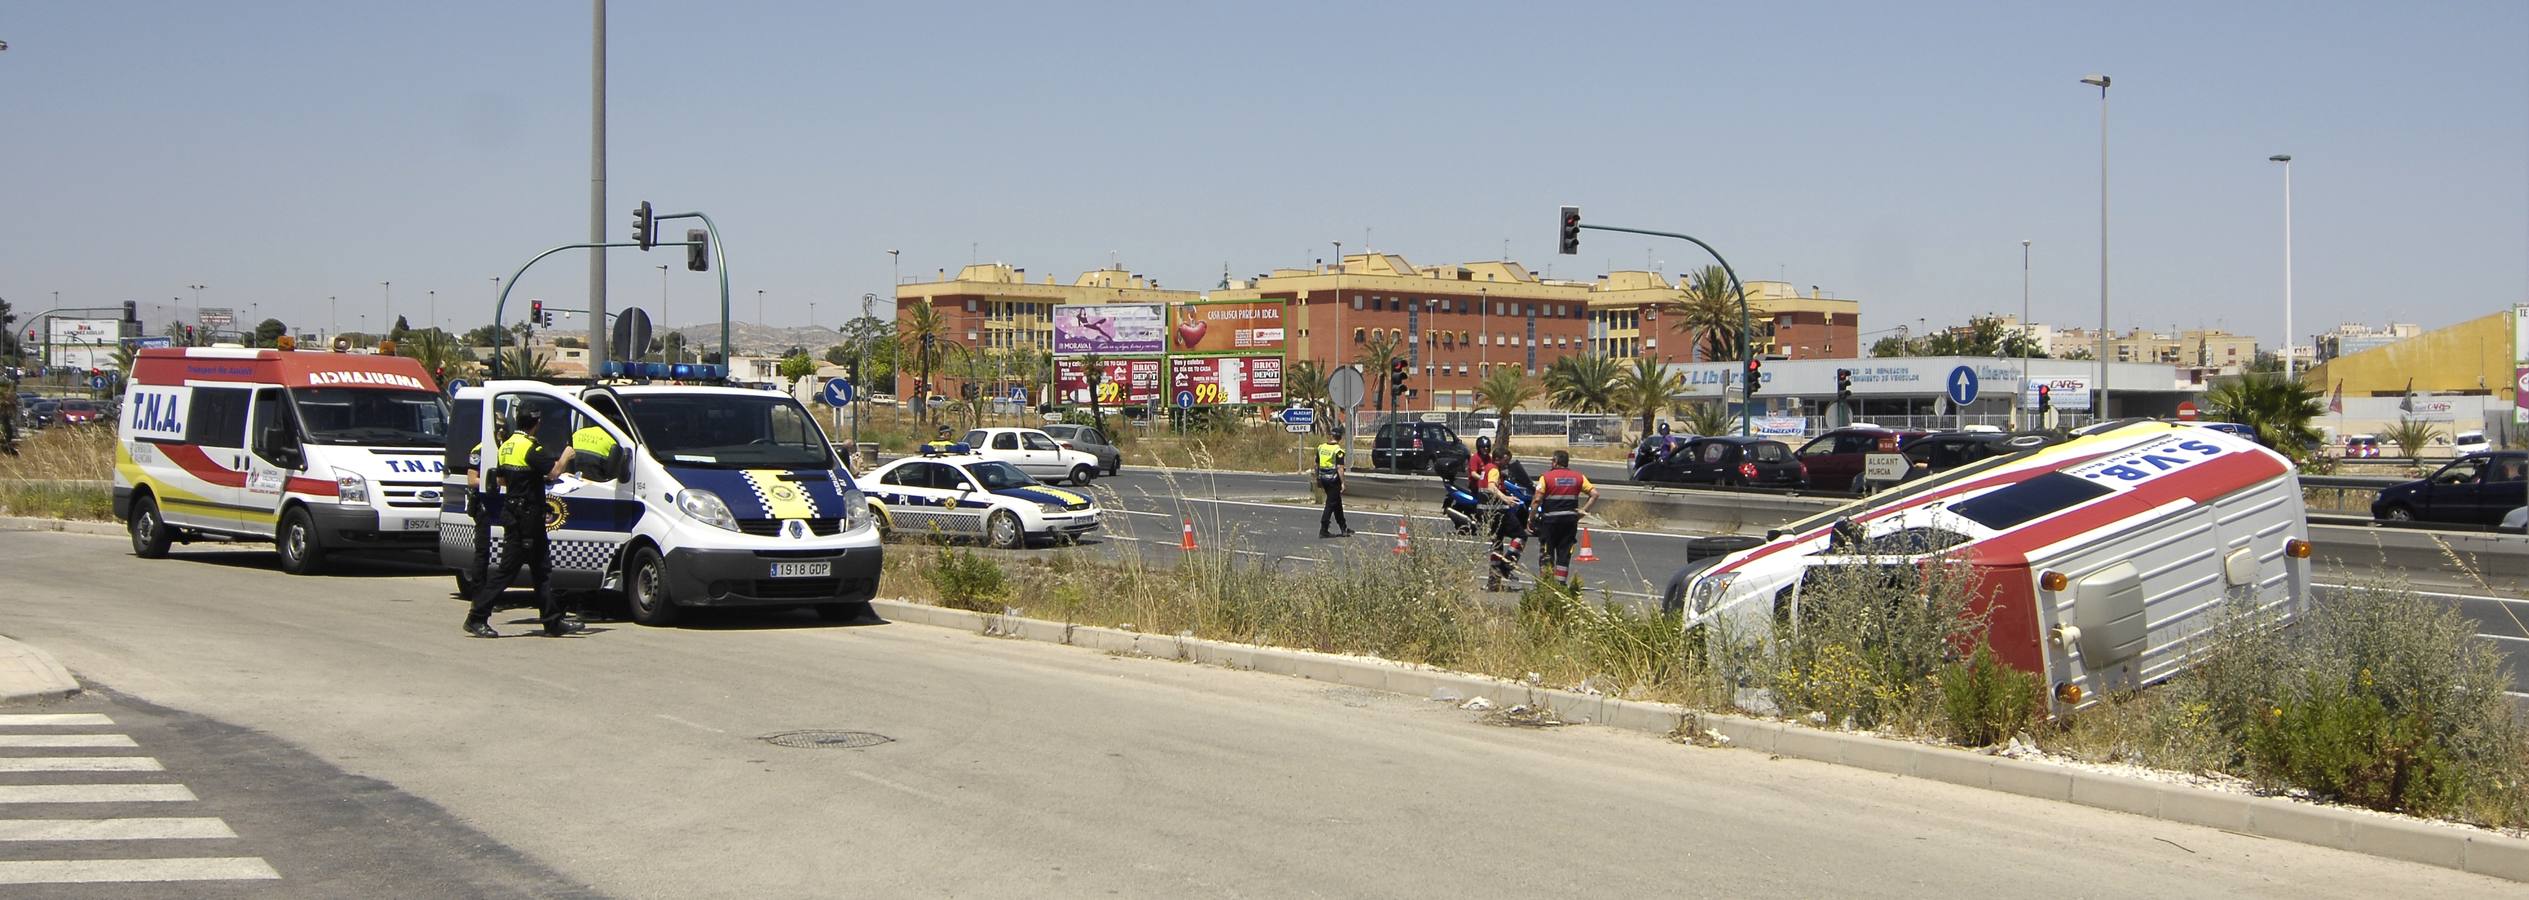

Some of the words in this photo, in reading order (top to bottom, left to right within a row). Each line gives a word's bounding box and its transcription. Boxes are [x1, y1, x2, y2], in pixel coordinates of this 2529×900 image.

[1262, 308, 1279, 319] IDEAL
[1254, 361, 1279, 369] BRICO
[2050, 380, 2084, 389] CARS
[1098, 382, 1119, 402] 39
[132, 392, 182, 433] T.N.A.
[2084, 440, 2223, 481] S.V.B.
[899, 494, 911, 506] PL
[410, 520, 430, 529] 9574
[780, 563, 806, 575] 1918
[809, 563, 828, 575] GDP
